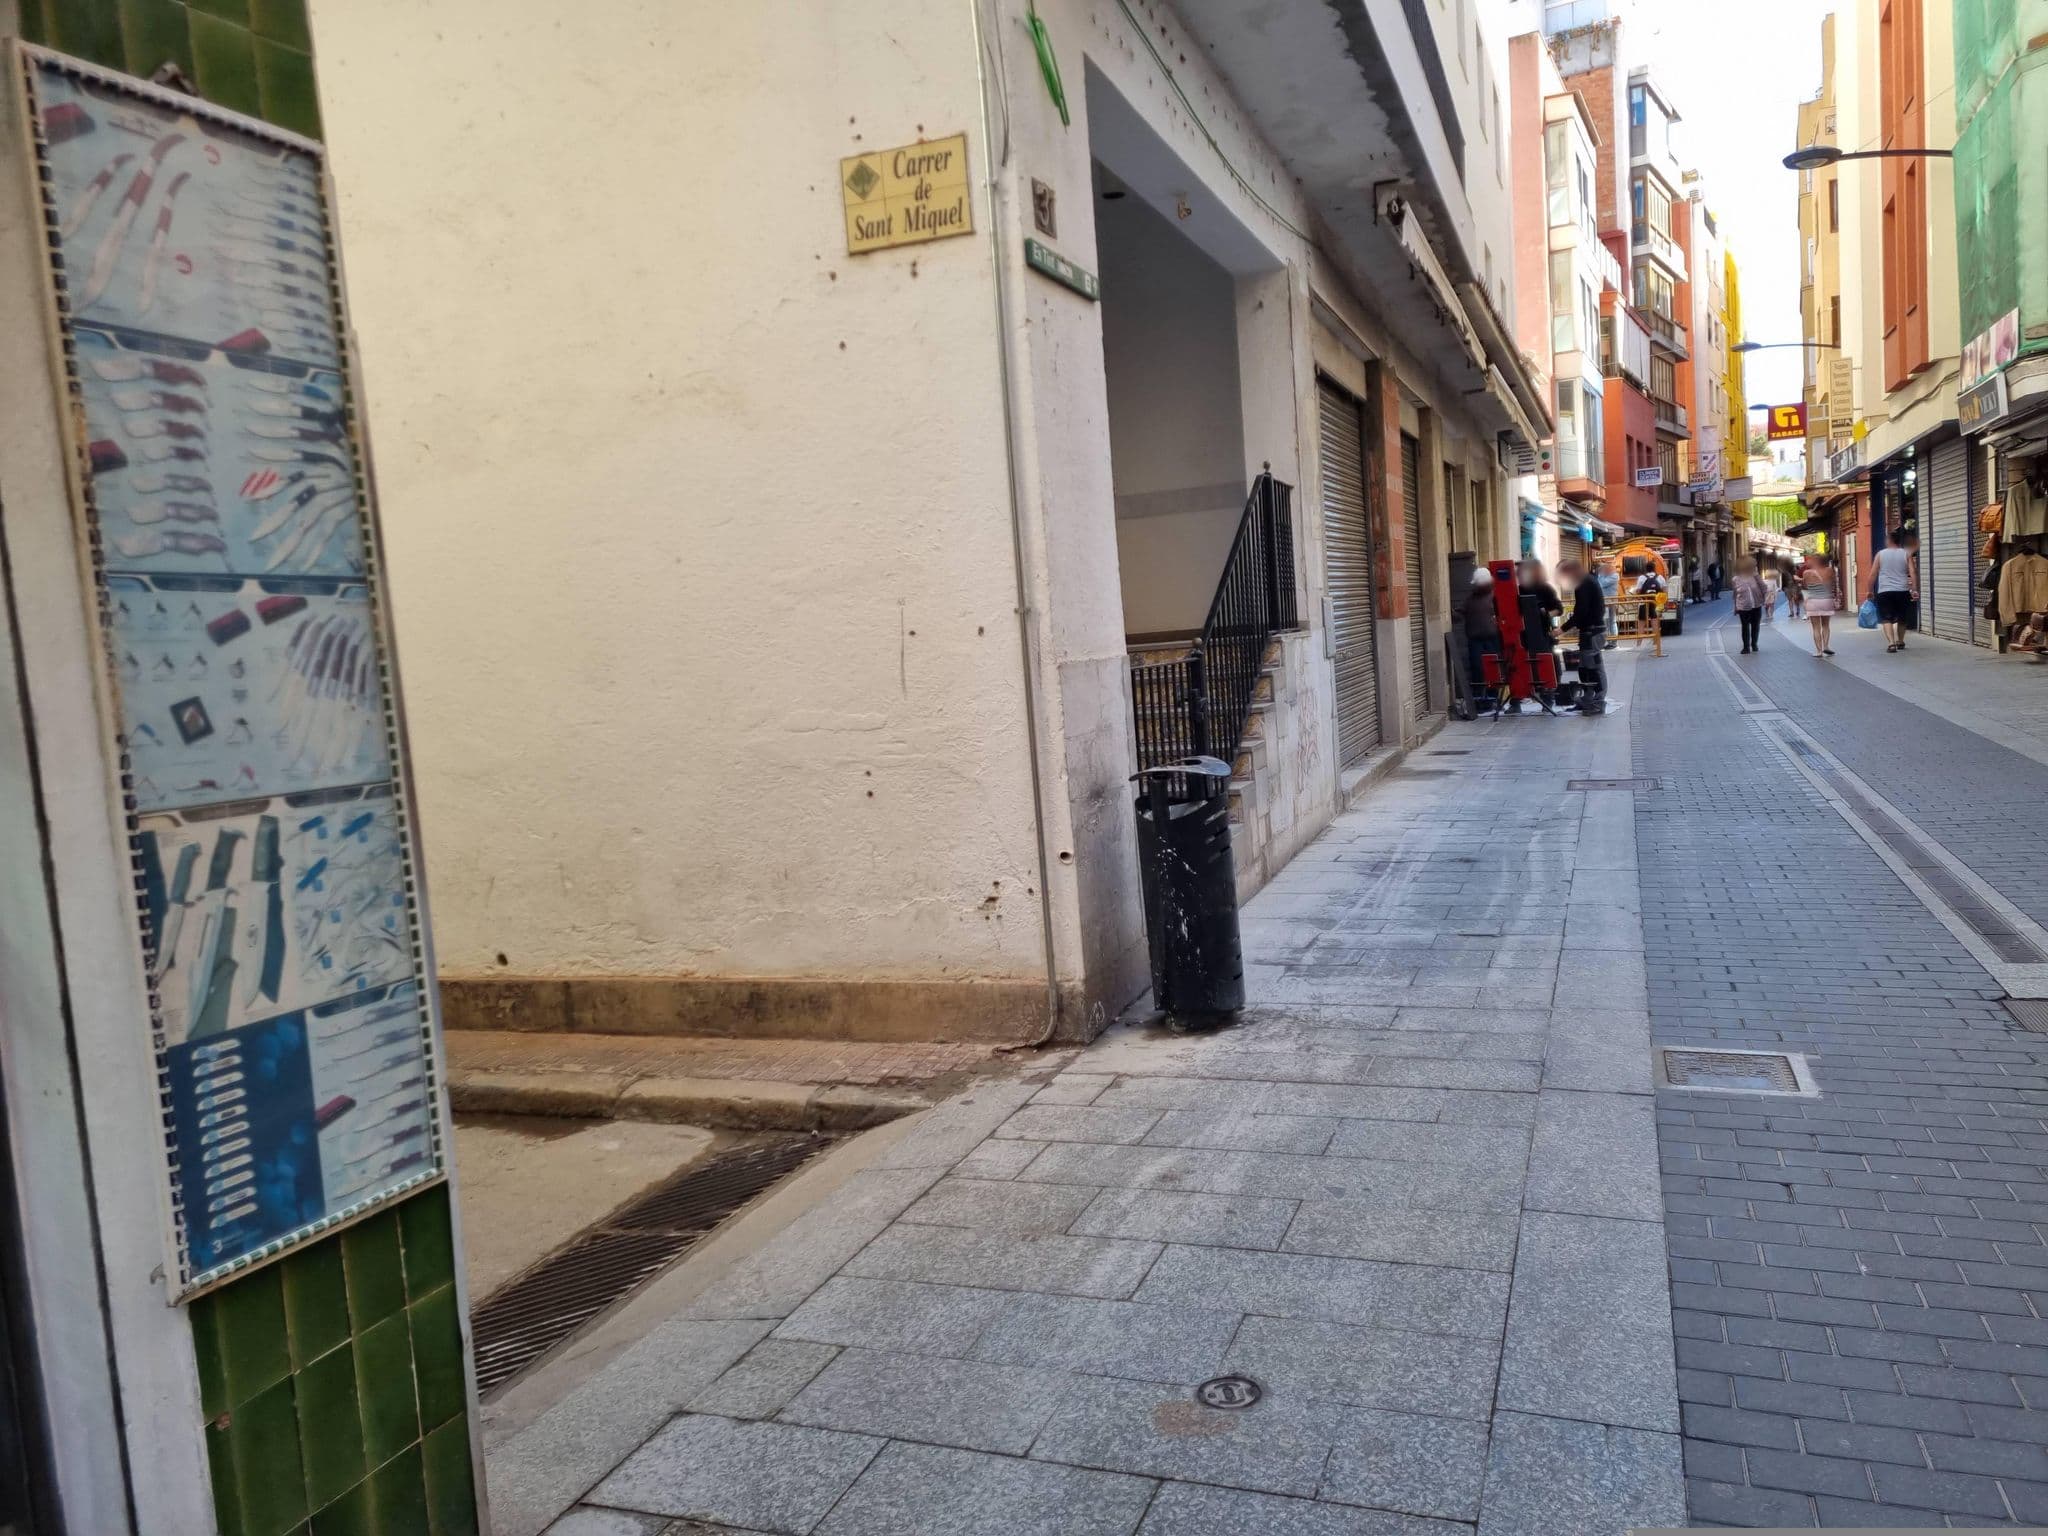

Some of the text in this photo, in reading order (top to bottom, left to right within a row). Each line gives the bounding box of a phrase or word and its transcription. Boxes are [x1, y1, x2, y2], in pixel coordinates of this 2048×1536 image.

[893, 150, 953, 180] Carrer
[914, 177, 933, 202] de
[854, 195, 963, 241] Sant Miquel
[1770, 429, 1804, 439] TABACS
